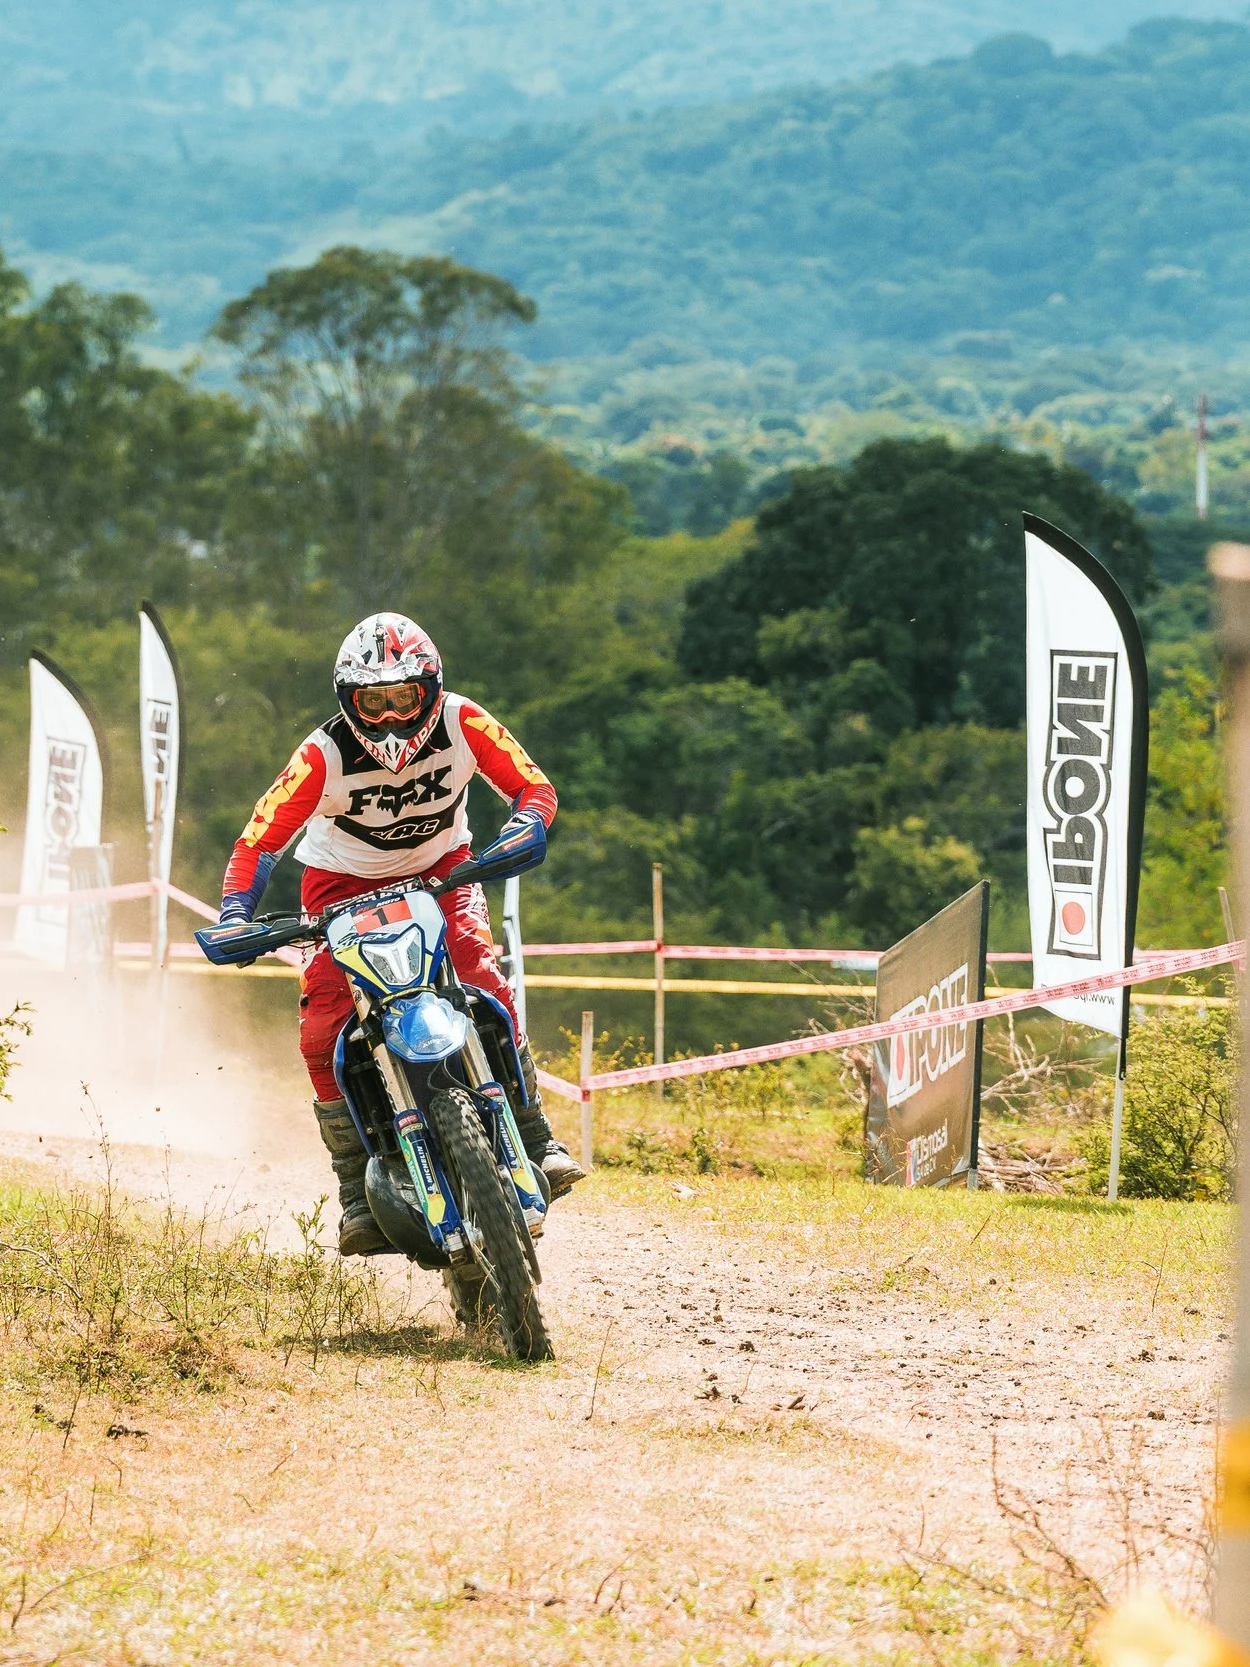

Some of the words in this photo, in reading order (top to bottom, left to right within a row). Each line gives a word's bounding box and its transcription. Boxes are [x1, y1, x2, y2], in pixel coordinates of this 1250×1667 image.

[345, 765, 452, 818] FOX
[372, 907, 389, 926] 1
[376, 897, 401, 908] MOTO
[417, 1145, 434, 1184] MICHELIN
